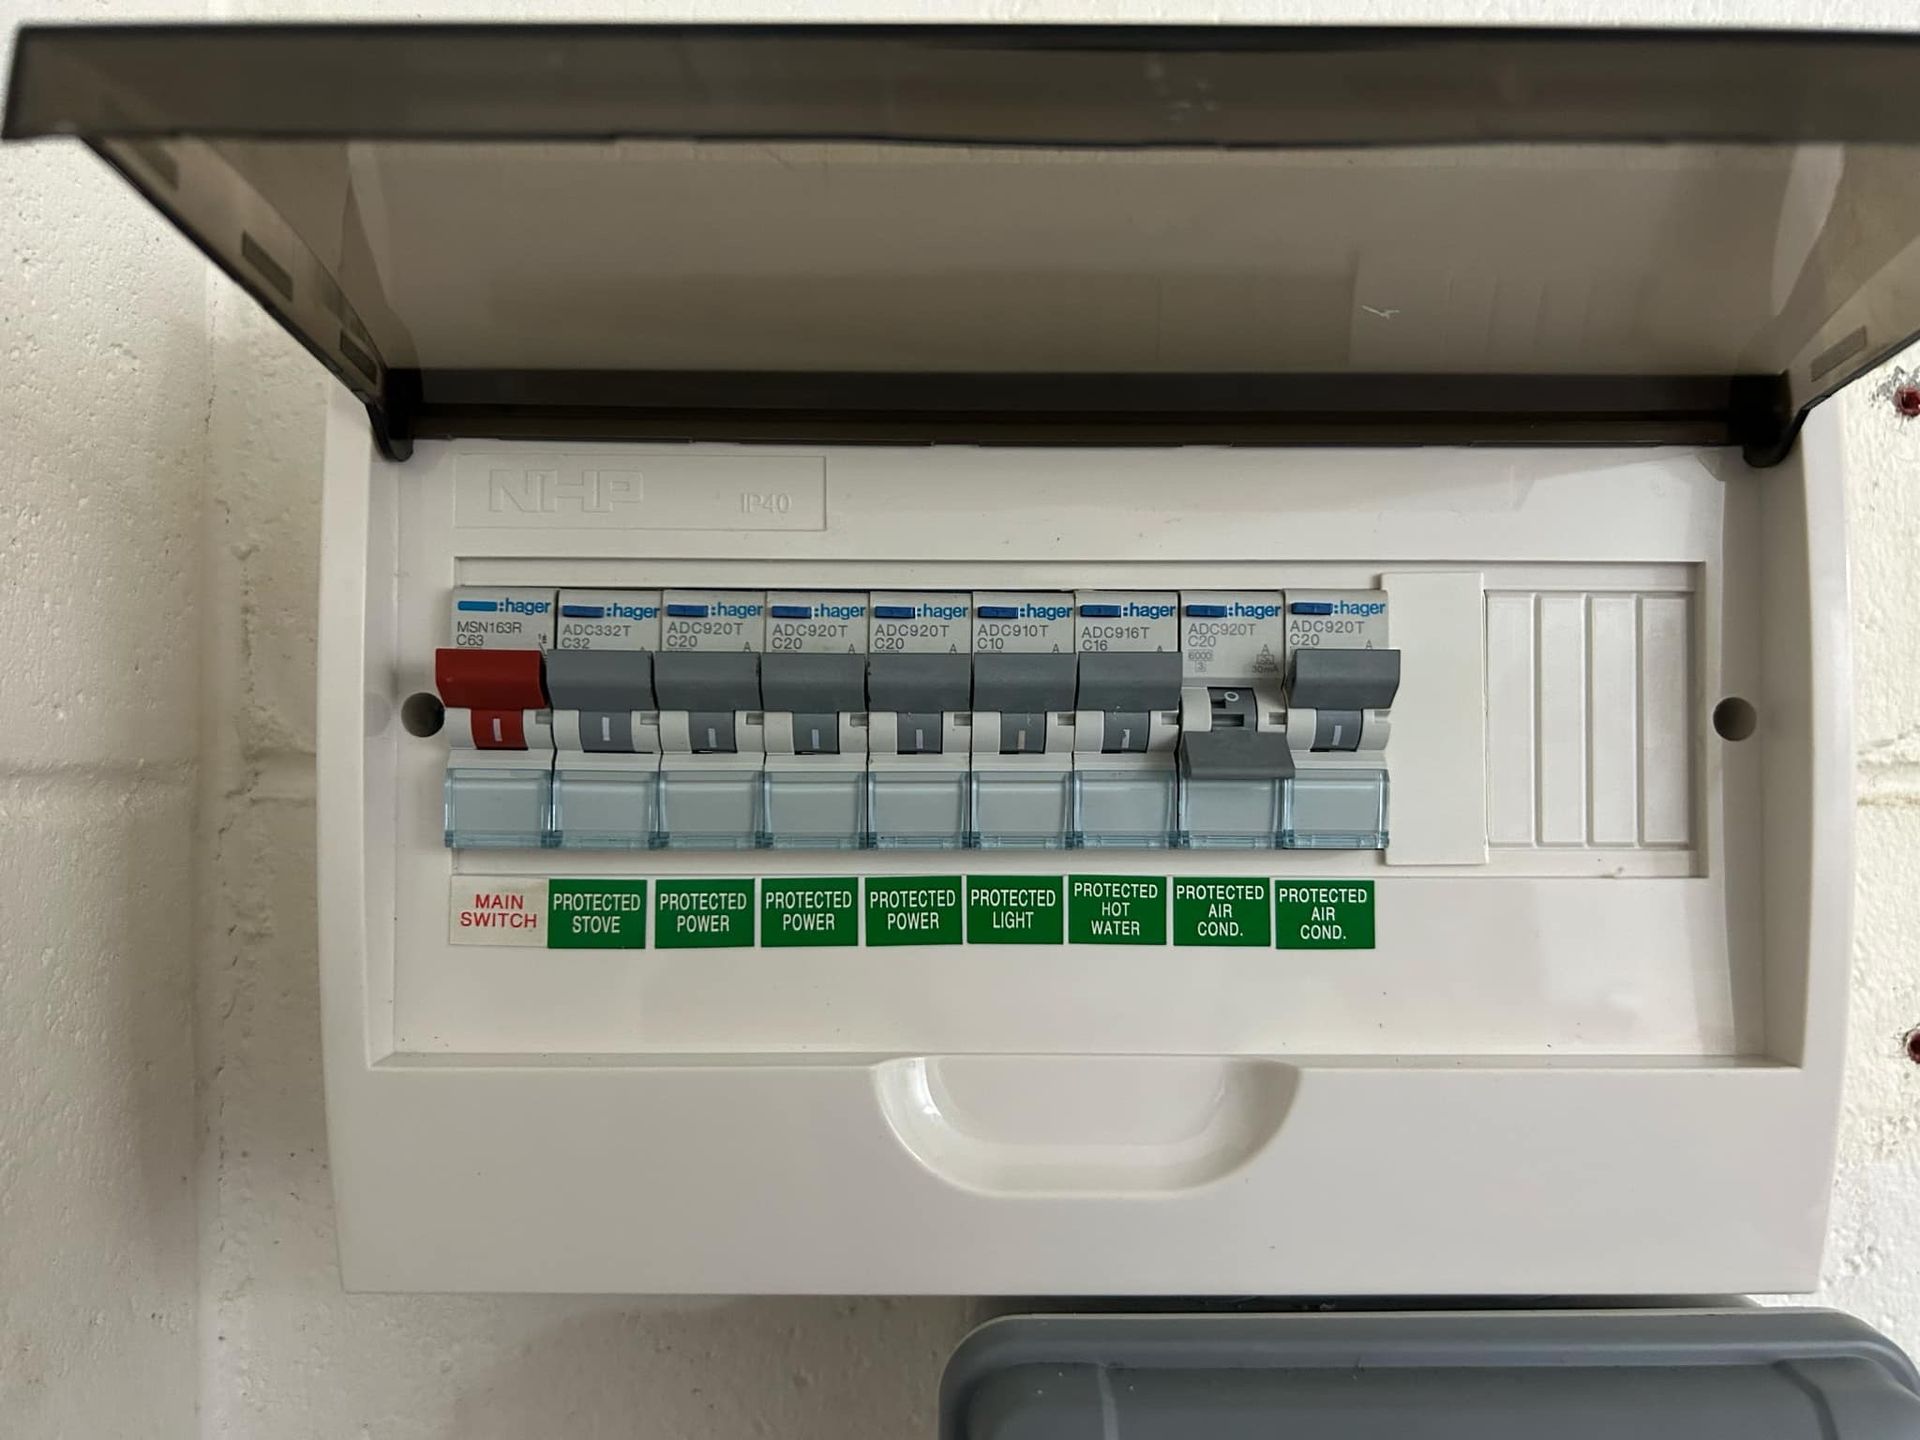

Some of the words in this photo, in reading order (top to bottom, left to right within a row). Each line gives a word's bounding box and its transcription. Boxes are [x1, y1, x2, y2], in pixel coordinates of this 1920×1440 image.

[489, 469, 643, 513] NHP
[741, 492, 792, 514] IP40
[457, 621, 522, 634] MSN163R
[563, 624, 631, 637] ADC332T
[667, 622, 743, 636] ADC920T
[772, 624, 848, 637] ADC920T
[875, 624, 950, 637] ADC920T
[978, 624, 1049, 637] ADC910T
[1082, 626, 1150, 639] ADC916T
[1188, 623, 1256, 636] ADC920T
[1290, 620, 1365, 634] ADC920T
[456, 633, 484, 646] C63
[561, 637, 589, 649] C32
[667, 635, 698, 648] C20
[772, 637, 802, 650] C20
[874, 637, 904, 650] C20
[977, 637, 1004, 650] C10
[1082, 639, 1108, 651] C16
[1188, 635, 1216, 647] C20
[1289, 633, 1320, 646] C20
[1074, 882, 1158, 898] PROTECTED
[1177, 885, 1264, 900] PROTECTED
[1279, 888, 1367, 903] PROTECTED
[475, 894, 524, 910] MAIN
[553, 893, 641, 911] PROTECTED
[660, 893, 747, 911] PROTECTED
[766, 891, 852, 909] PROTECTED
[870, 890, 956, 908] PROTECTED
[971, 889, 1056, 907] PROTECTED
[1101, 902, 1130, 916] HOT
[1208, 904, 1233, 918] AIR
[1311, 906, 1336, 921] AIR
[460, 912, 537, 928] SWITCH
[572, 916, 621, 934] STOVE
[677, 915, 730, 932] POWER
[783, 914, 835, 931] POWER
[887, 912, 940, 930] POWER
[993, 911, 1034, 929] LIGHT
[1091, 921, 1140, 936] WATER
[1197, 922, 1244, 937] COND.
[1300, 925, 1347, 940] COND.
